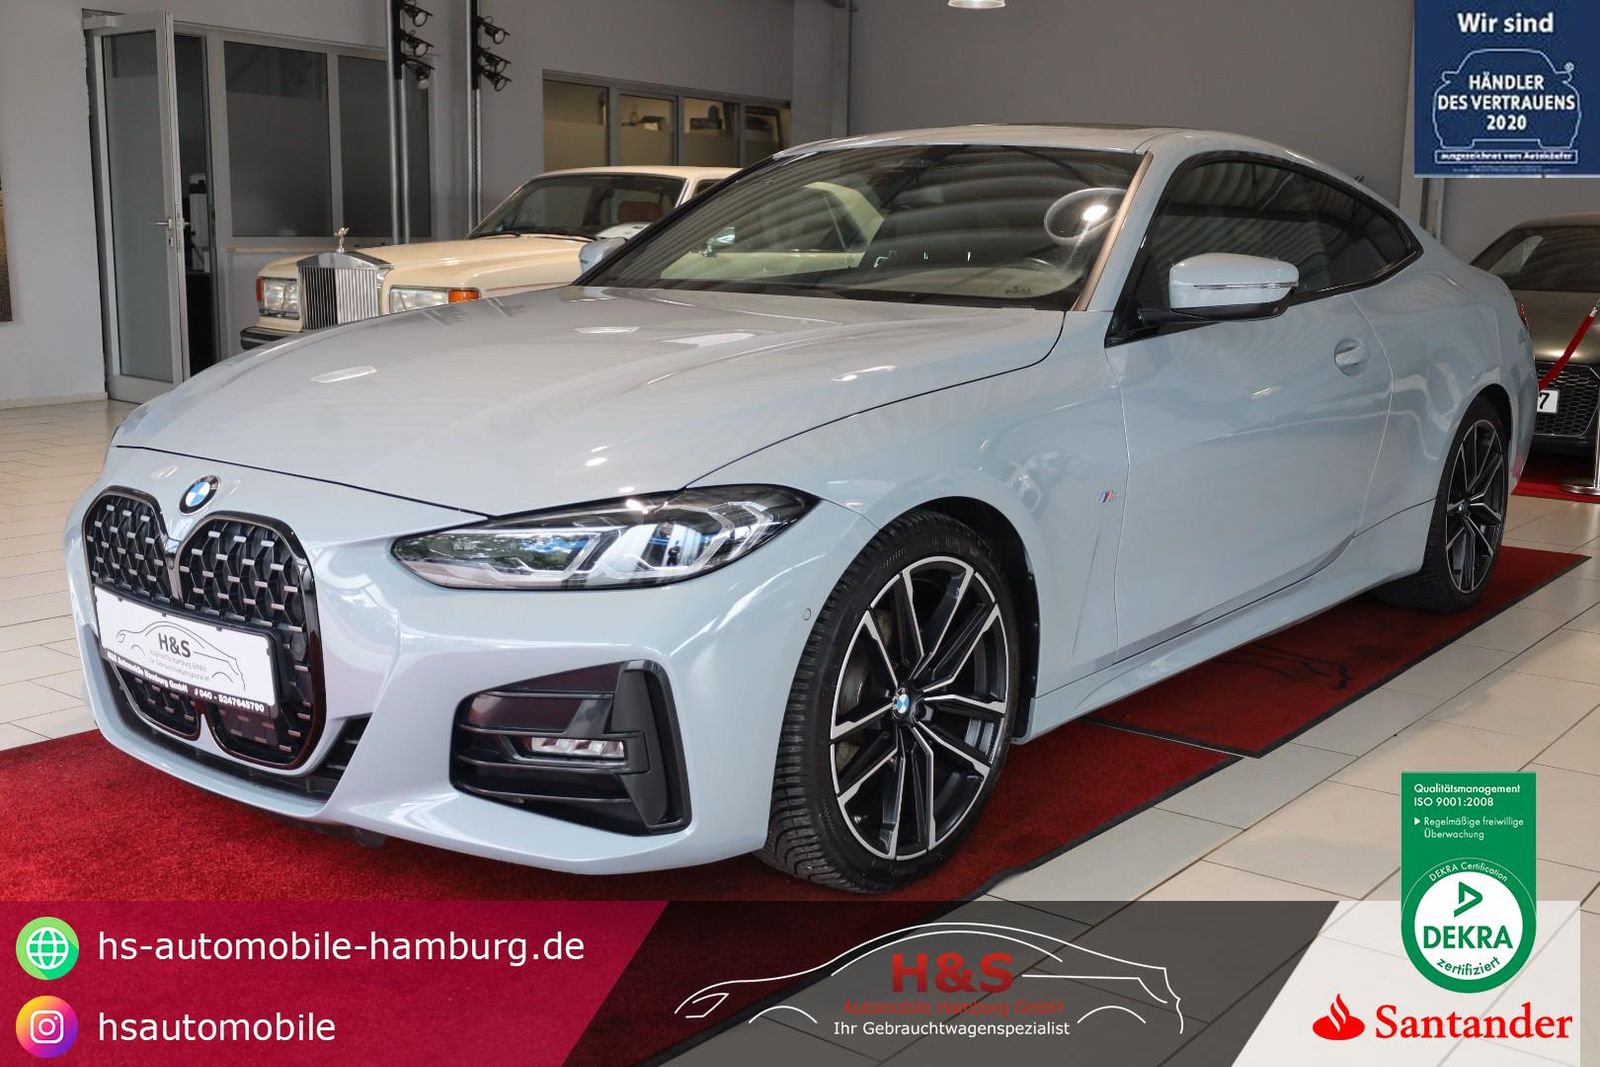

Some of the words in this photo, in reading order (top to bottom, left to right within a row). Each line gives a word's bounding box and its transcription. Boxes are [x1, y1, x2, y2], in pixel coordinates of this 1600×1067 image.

[1539, 392, 1550, 410] 7
[158, 632, 191, 658] H&S
[199, 689, 213, 700] 040
